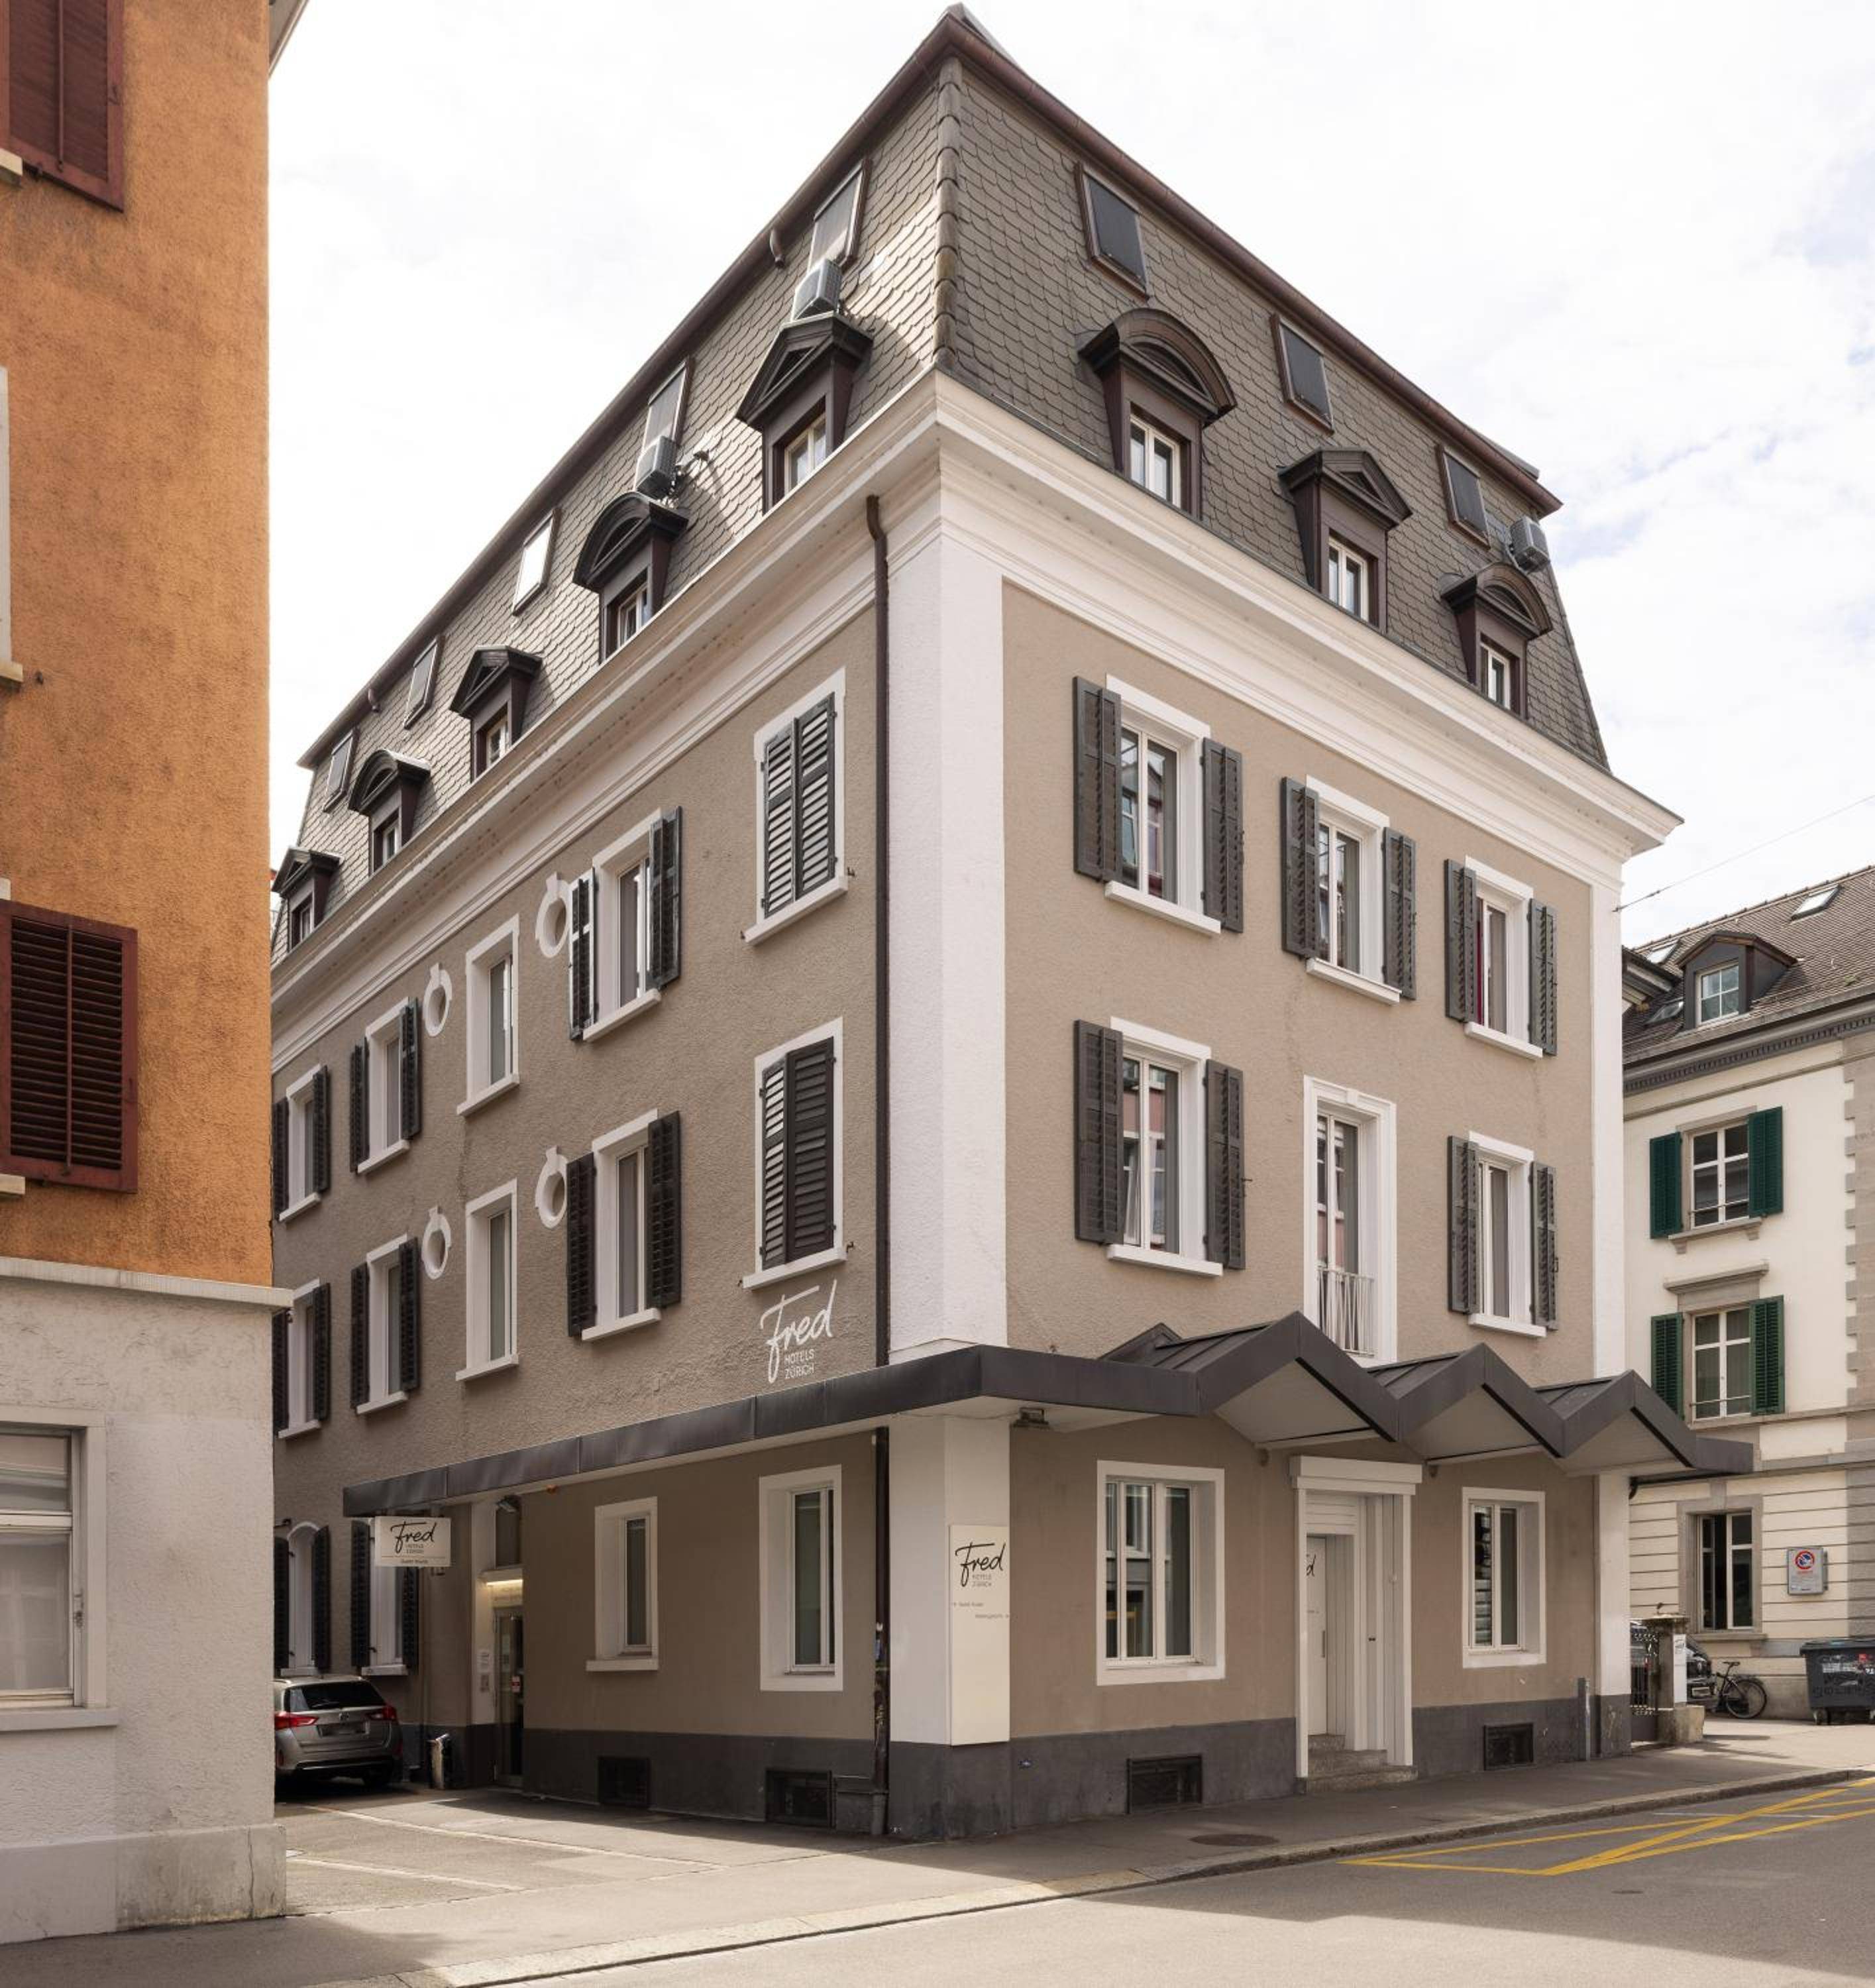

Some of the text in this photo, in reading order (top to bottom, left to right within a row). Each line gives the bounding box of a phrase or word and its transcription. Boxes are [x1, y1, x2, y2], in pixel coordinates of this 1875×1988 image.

[760, 1279, 837, 1384] Fred
[784, 1349, 815, 1366] HOTELS
[784, 1362, 815, 1379] ZÜRICH
[390, 1521, 437, 1554] Fred
[955, 1542, 1006, 1587] Fred
